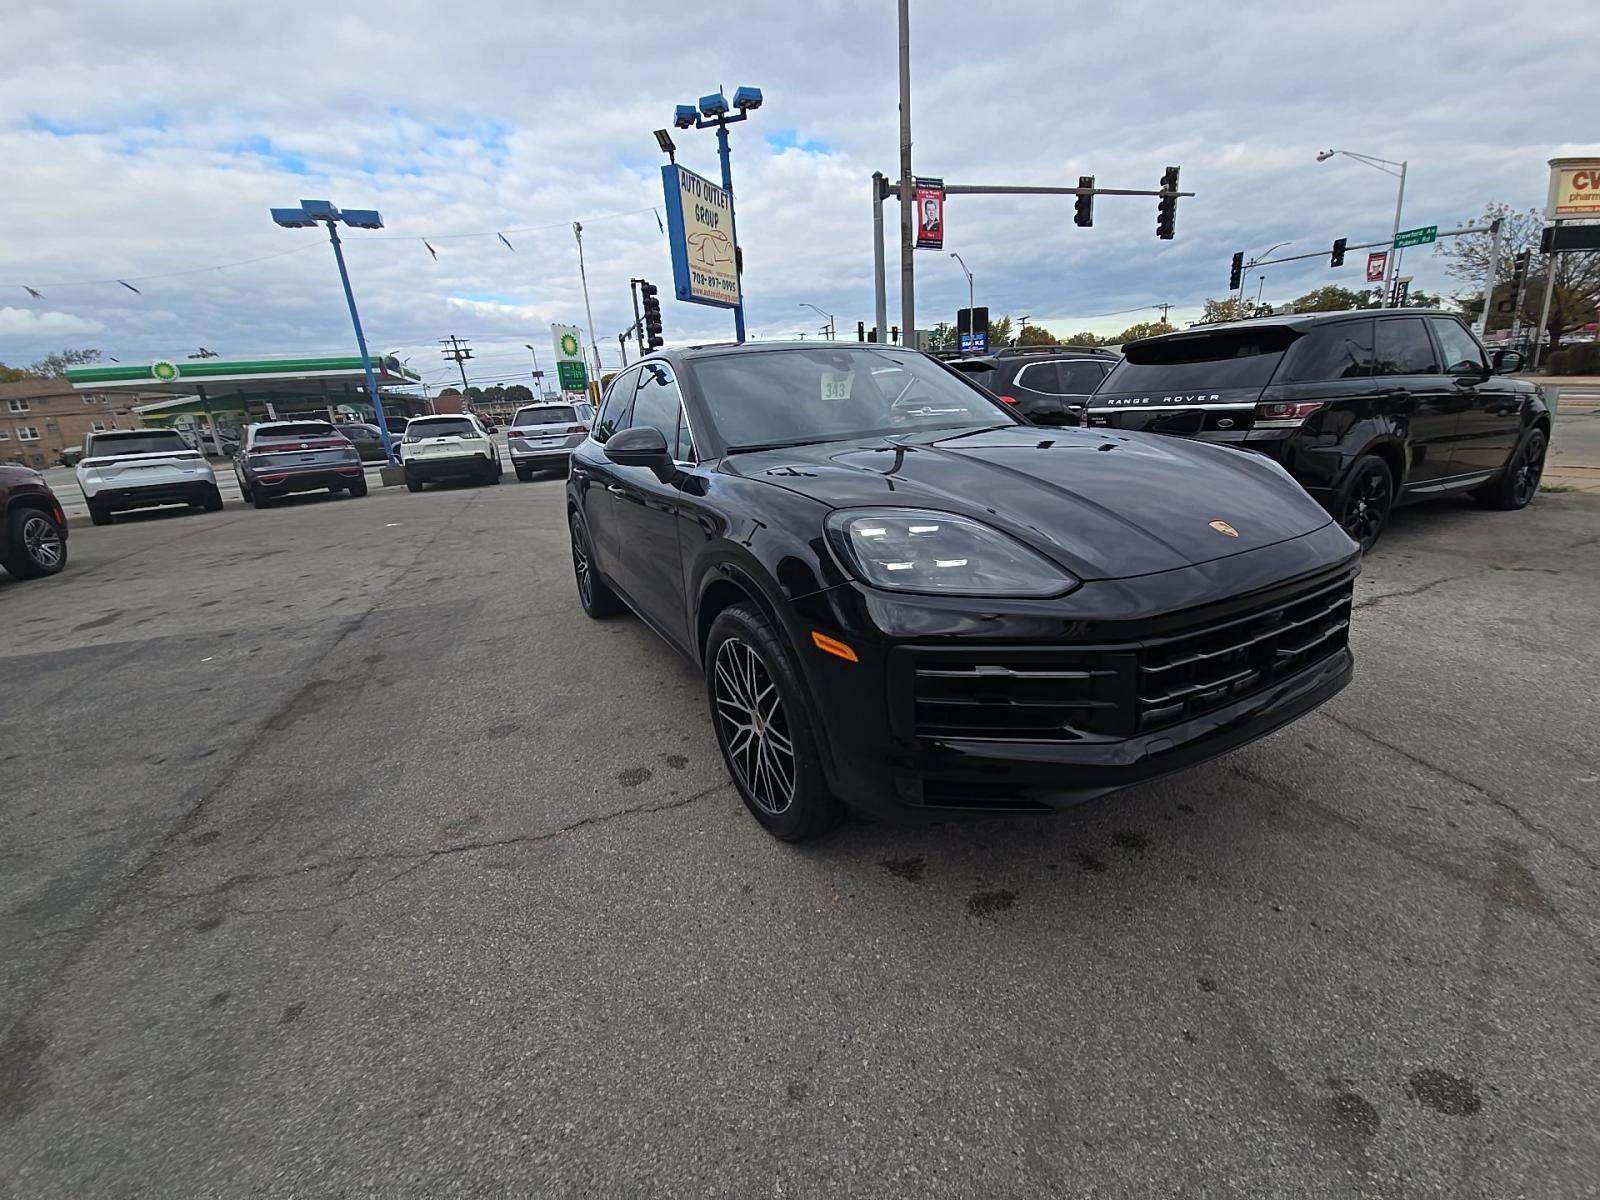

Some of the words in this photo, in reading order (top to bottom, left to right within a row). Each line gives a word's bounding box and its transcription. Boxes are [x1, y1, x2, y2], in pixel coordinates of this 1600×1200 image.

[681, 171, 701, 198] AUTO
[703, 183, 729, 210] OUTLET
[695, 203, 719, 229] GROUP
[825, 383, 846, 398] 343
[1107, 397, 1150, 405] RANGE
[1163, 394, 1220, 403] ROVER
